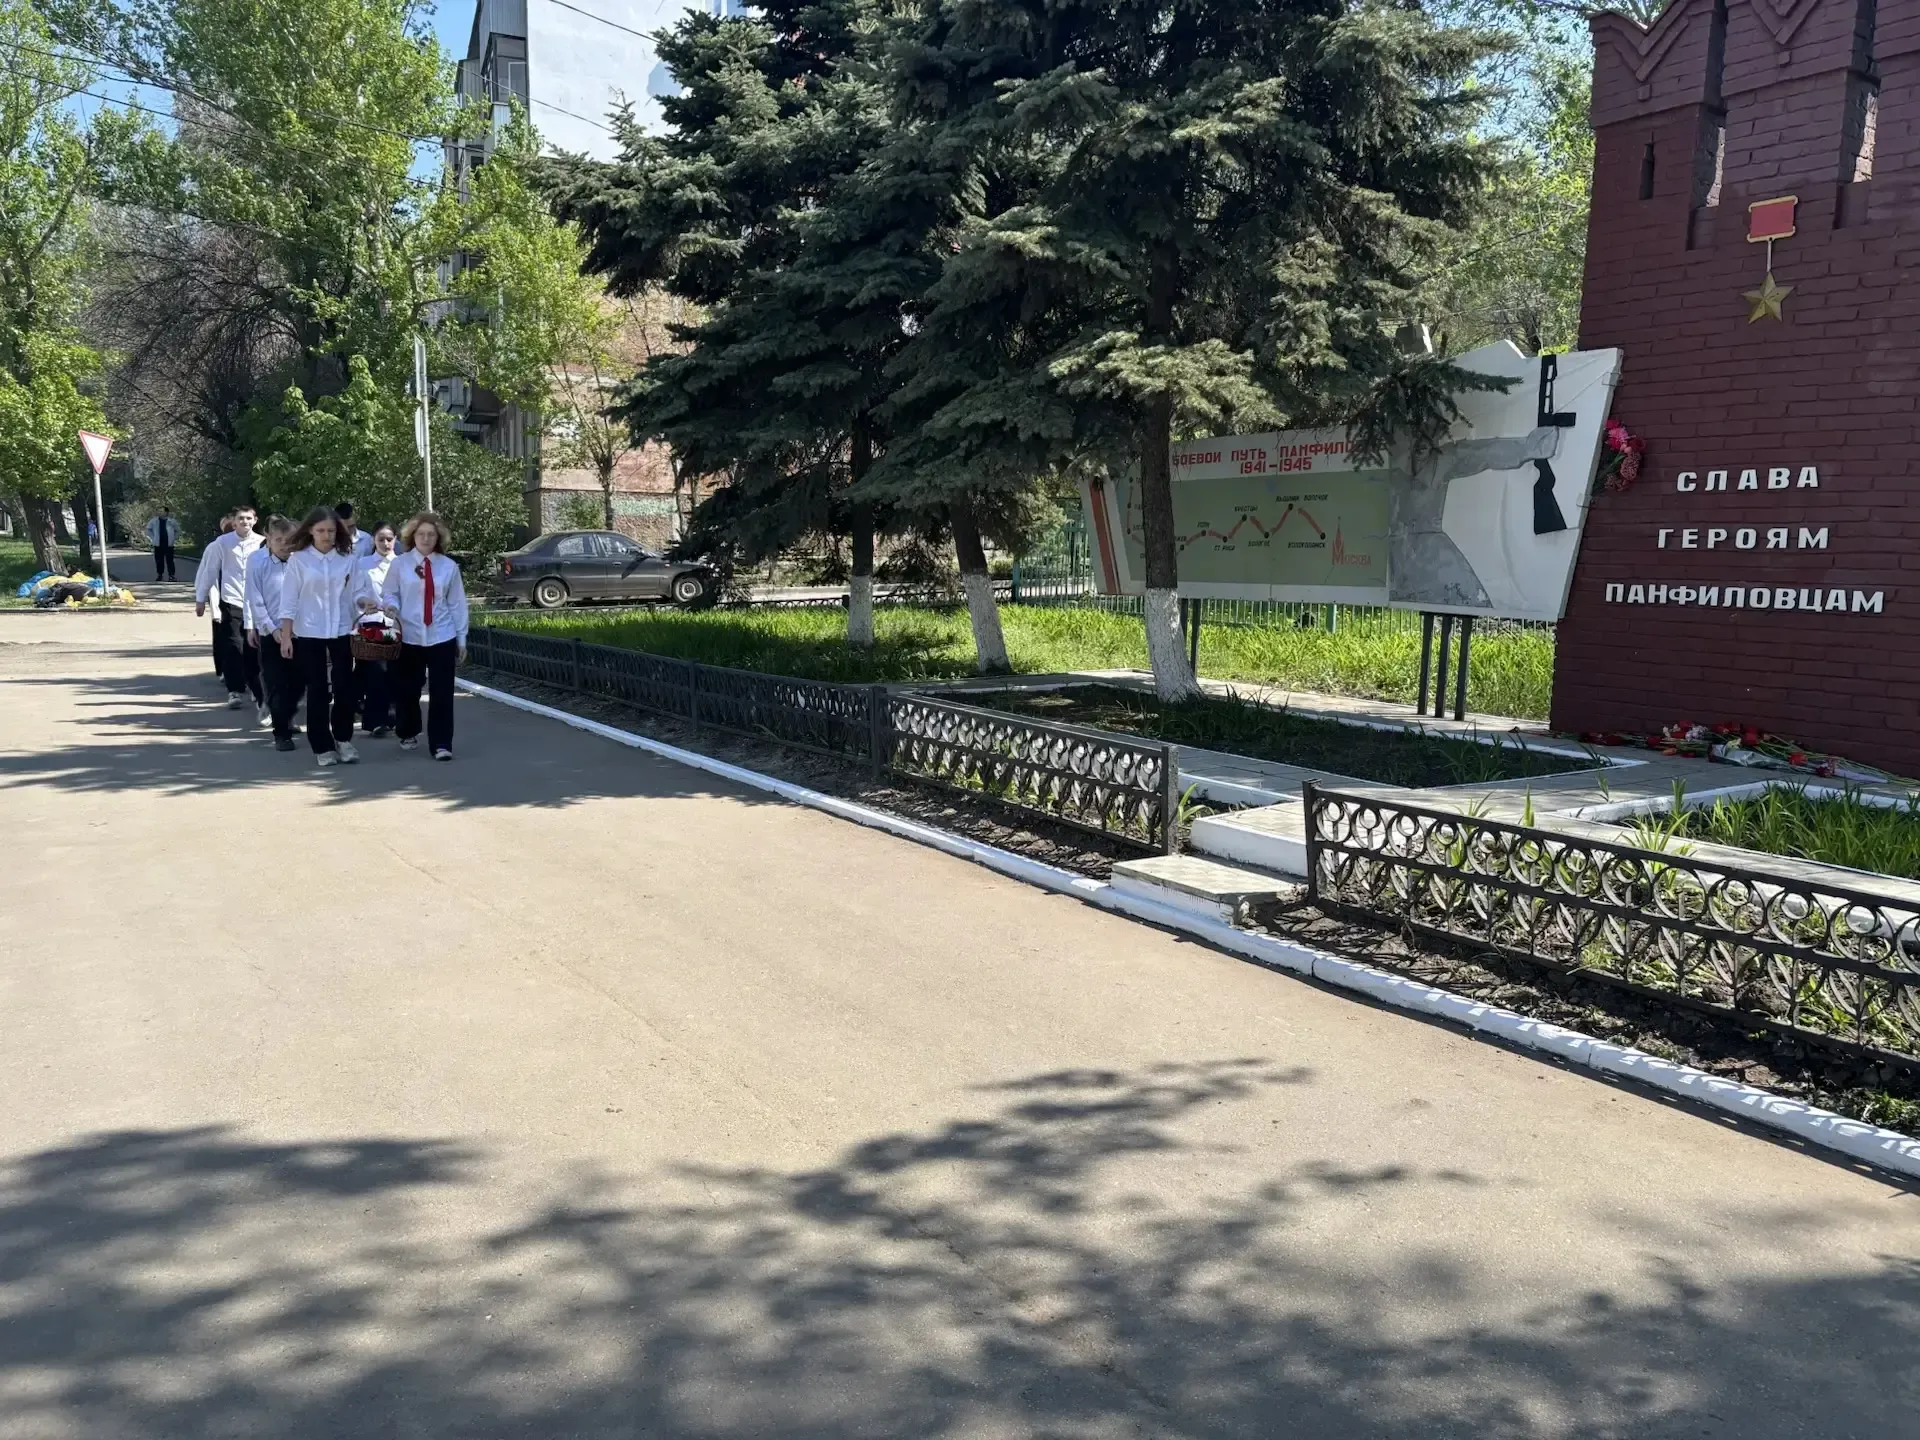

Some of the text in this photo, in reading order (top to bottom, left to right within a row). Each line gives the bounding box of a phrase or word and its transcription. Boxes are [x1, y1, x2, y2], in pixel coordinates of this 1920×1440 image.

[1231, 448, 1267, 462] ПУТЬ
[1280, 440, 1357, 458] ПАНФИЛО
[1240, 457, 1313, 475] 1941-1945
[1676, 466, 1819, 492] СЛАВА
[1657, 527, 1830, 549] ГЕРОЯМ
[1605, 583, 1885, 613] ПАНФИЛОВЦАМ
